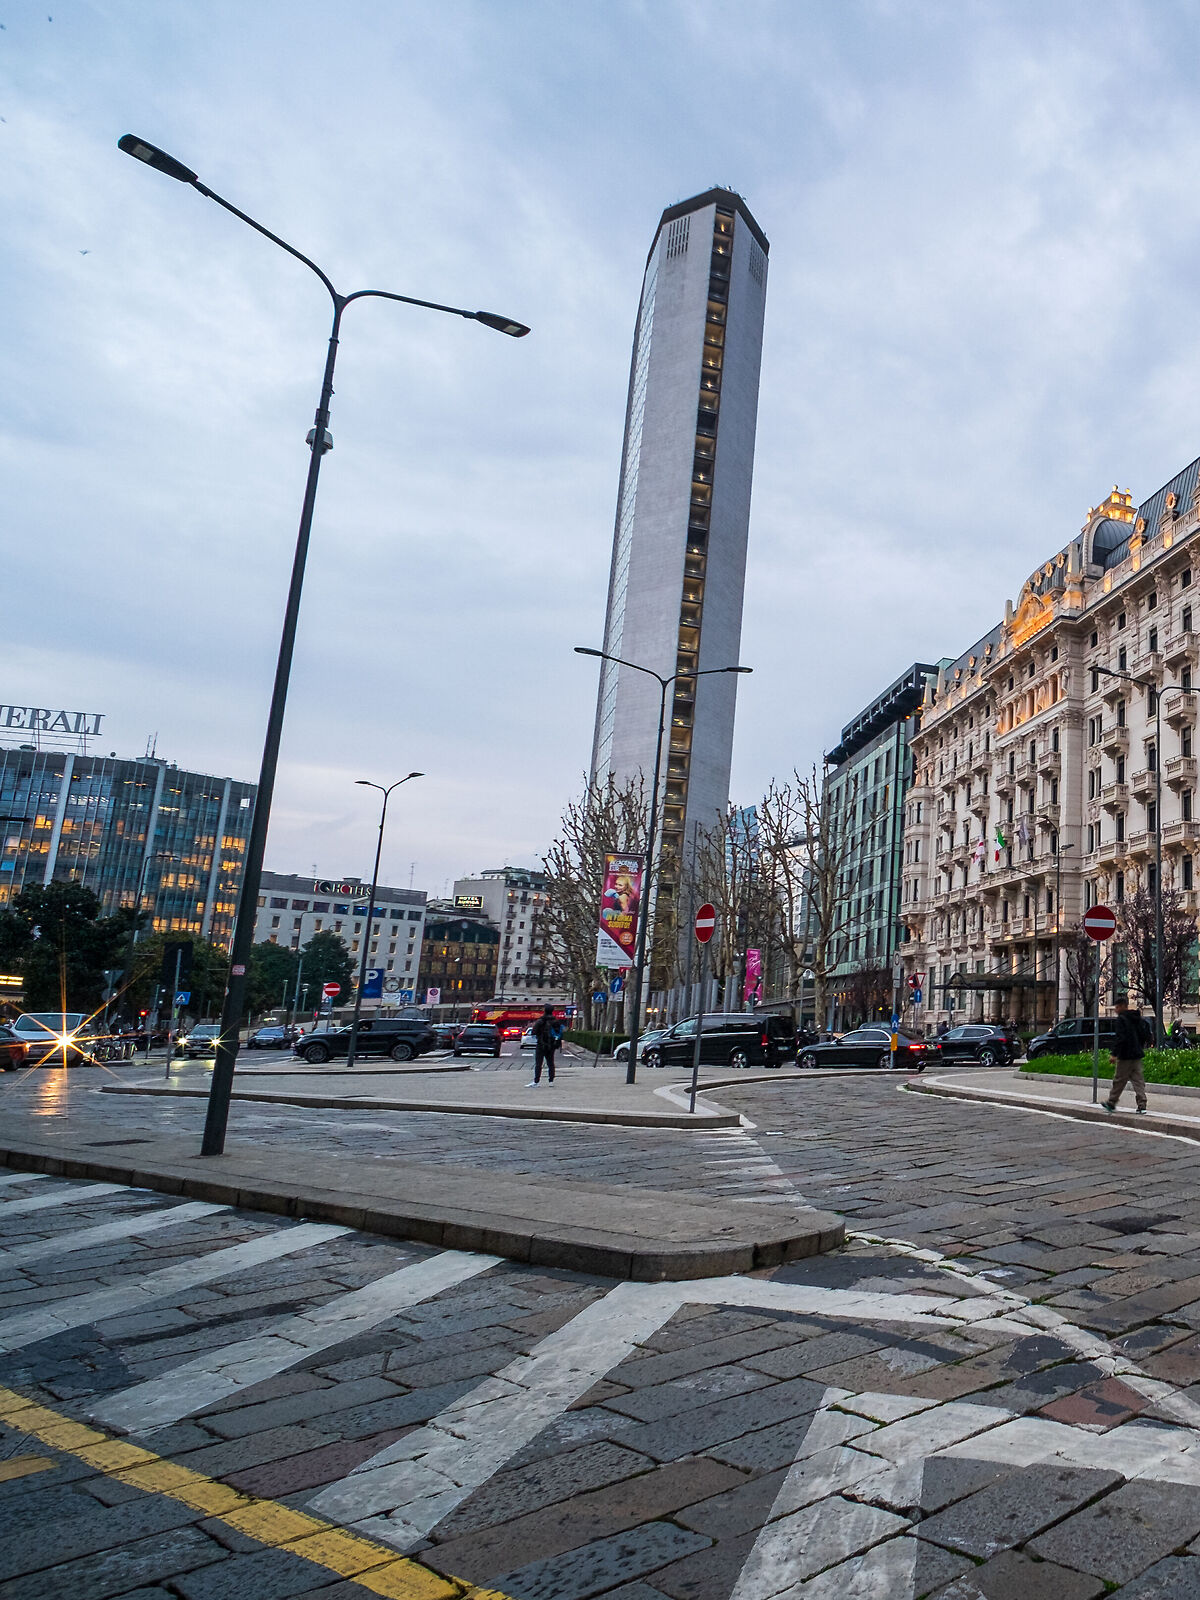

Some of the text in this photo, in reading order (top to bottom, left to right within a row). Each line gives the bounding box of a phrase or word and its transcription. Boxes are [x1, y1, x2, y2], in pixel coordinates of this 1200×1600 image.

[0, 705, 106, 736] ERALI
[332, 883, 372, 897] HOTELS
[364, 970, 379, 985] P
